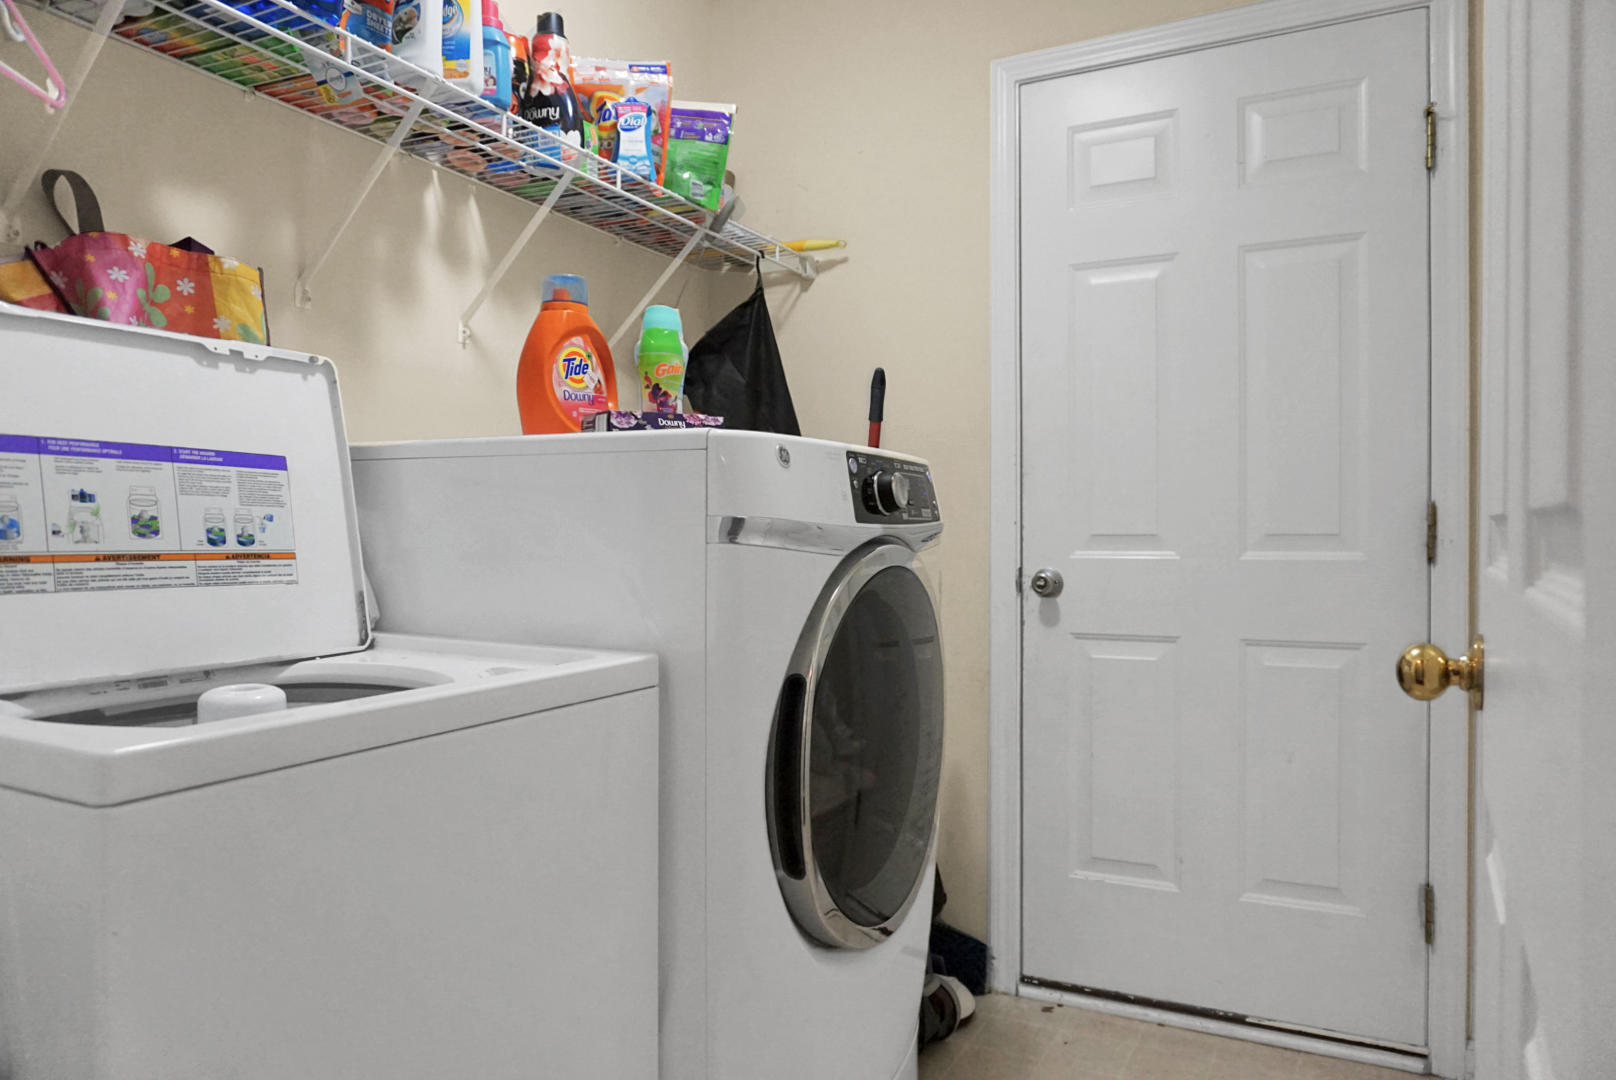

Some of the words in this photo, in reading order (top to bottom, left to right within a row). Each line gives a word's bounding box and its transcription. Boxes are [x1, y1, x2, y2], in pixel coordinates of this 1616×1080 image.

[525, 106, 560, 121] Downy
[620, 115, 646, 127] Dial
[562, 357, 589, 380] Tide
[563, 389, 595, 406] Downy
[657, 417, 686, 429] Downy
